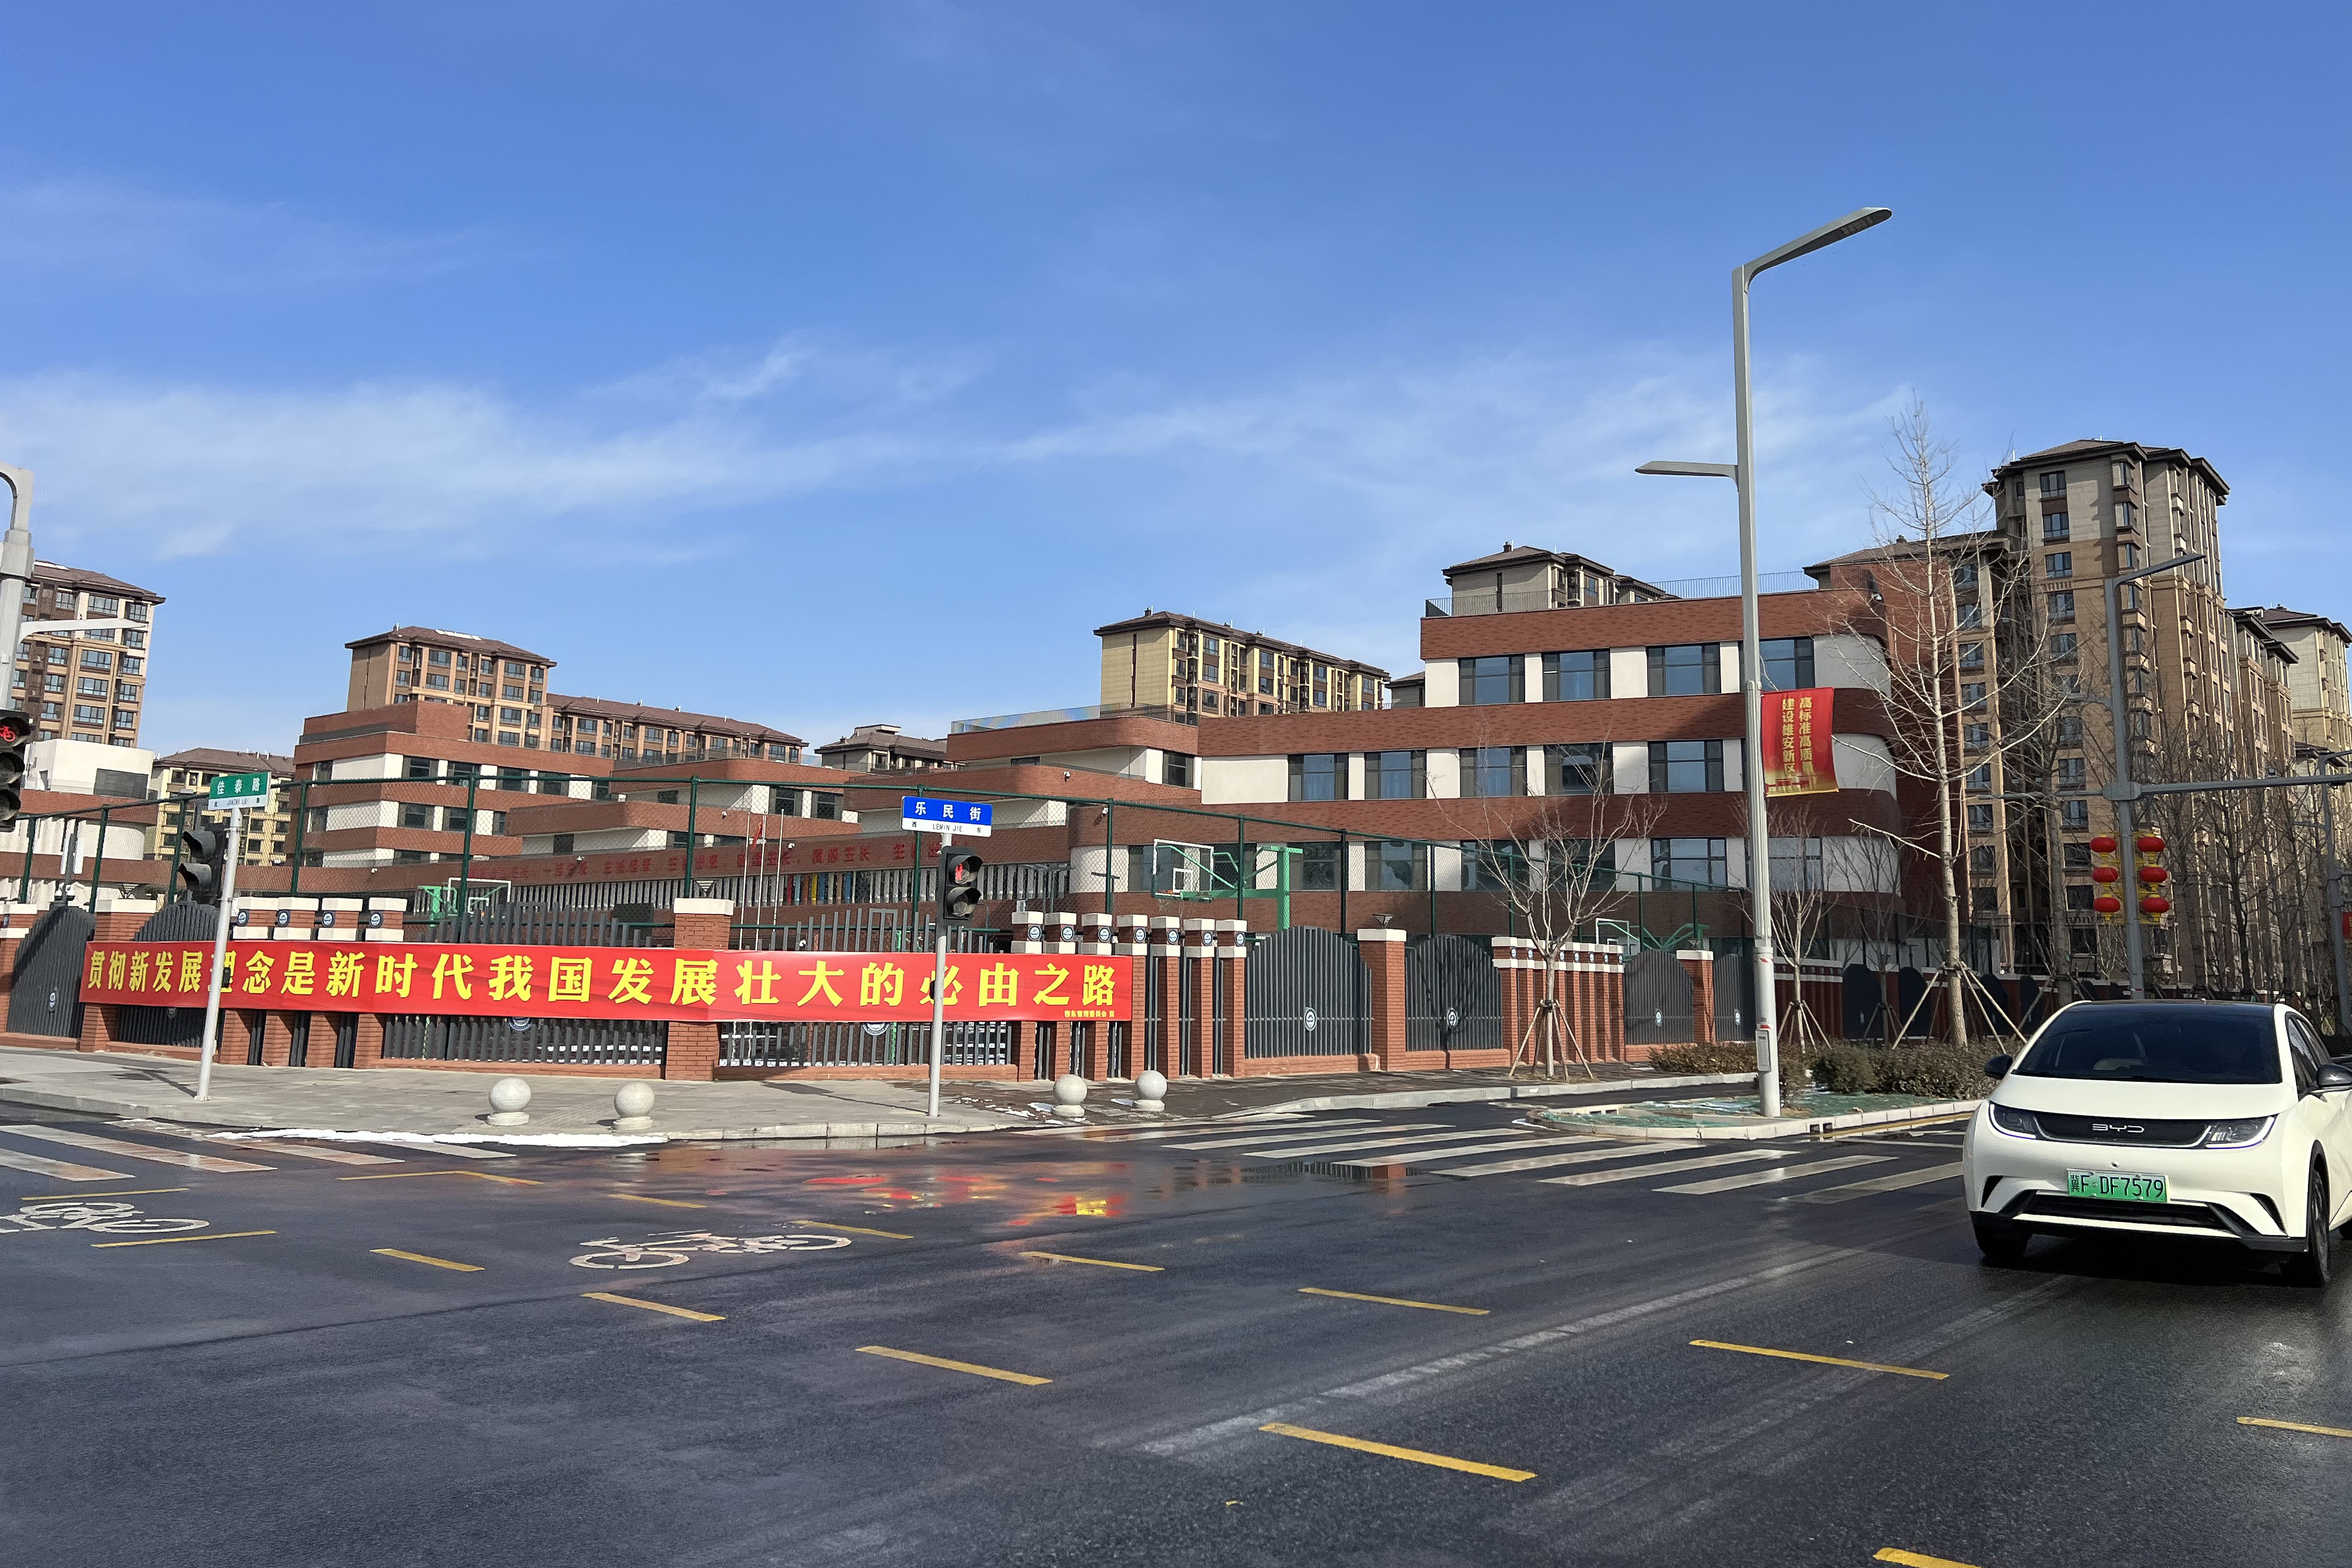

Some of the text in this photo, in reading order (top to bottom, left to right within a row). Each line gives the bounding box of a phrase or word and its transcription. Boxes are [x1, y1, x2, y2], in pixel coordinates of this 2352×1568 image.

[1782, 698, 1796, 777] 建设雄安新区
[217, 777, 260, 795] 佳泰路
[915, 802, 981, 821] 乐民街
[2092, 1123, 2145, 1133] BYD
[2099, 1176, 2164, 1198] DF7579
